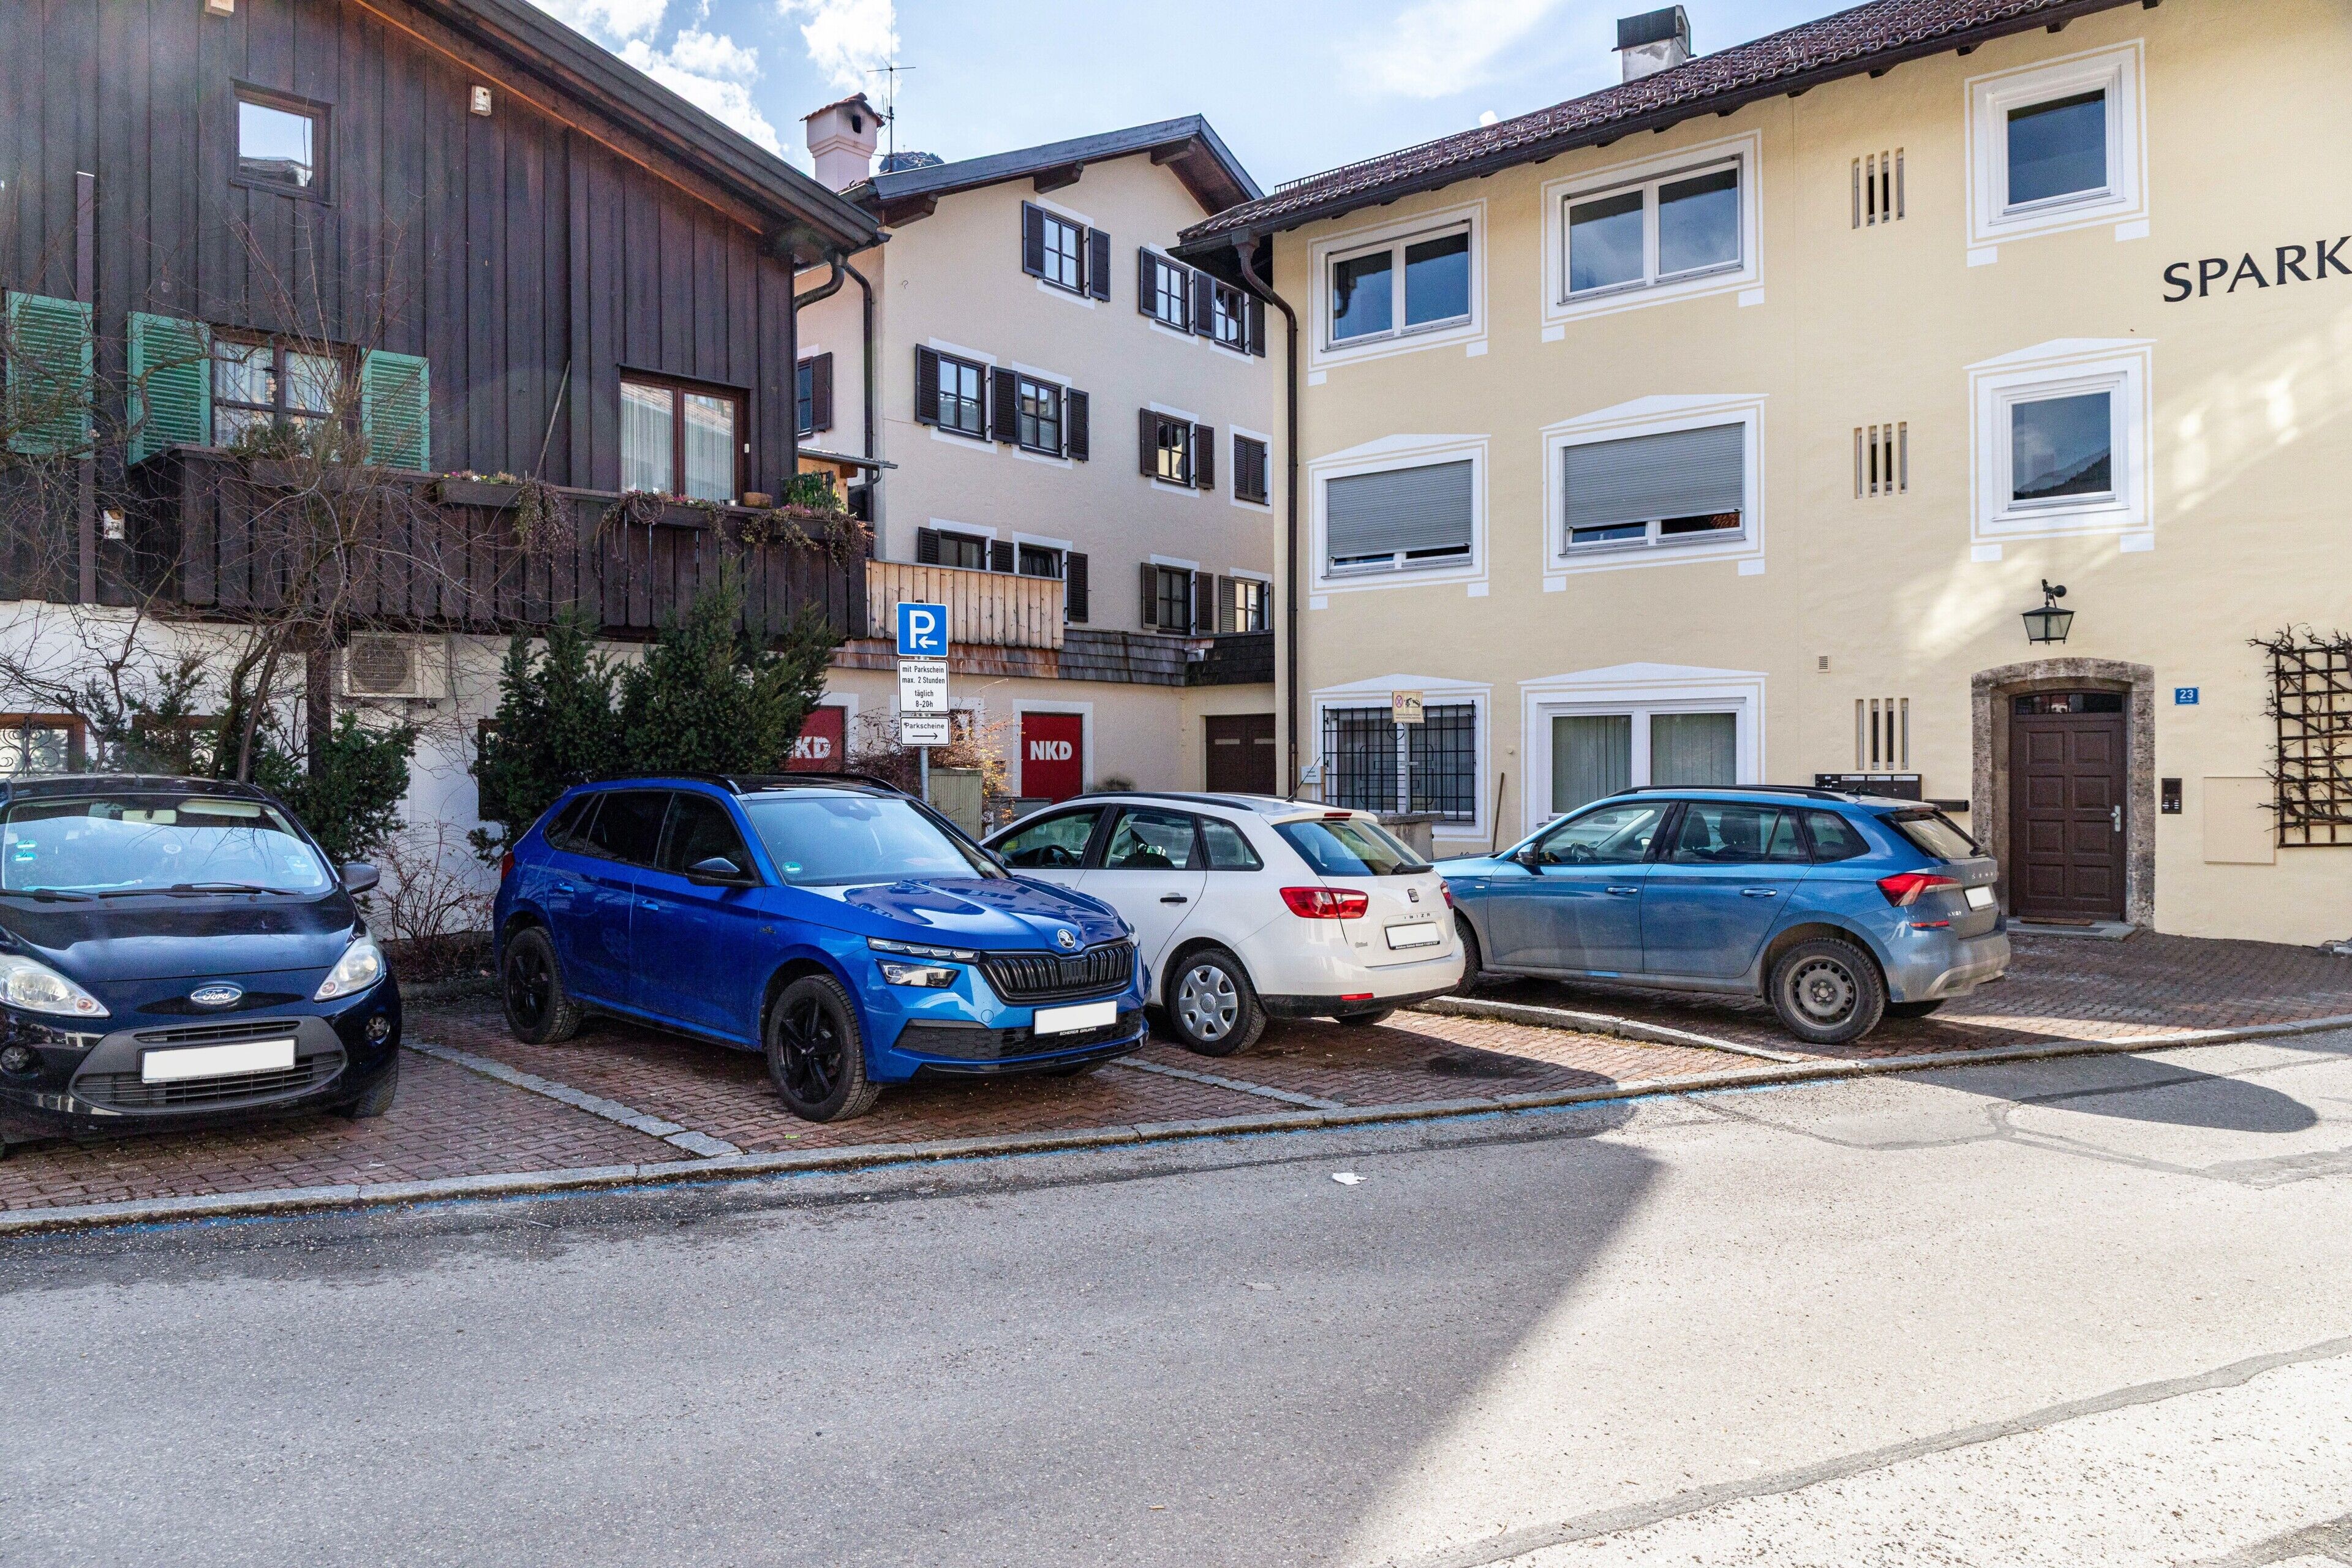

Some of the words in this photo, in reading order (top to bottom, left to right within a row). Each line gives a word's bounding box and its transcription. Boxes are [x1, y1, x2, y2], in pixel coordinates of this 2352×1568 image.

[2163, 235, 2352, 303] SPARK
[910, 610, 935, 648] P
[914, 690, 933, 698] täglich
[2180, 689, 2193, 698] 23
[1030, 741, 1072, 760] NKD
[202, 989, 230, 1000] Ford
